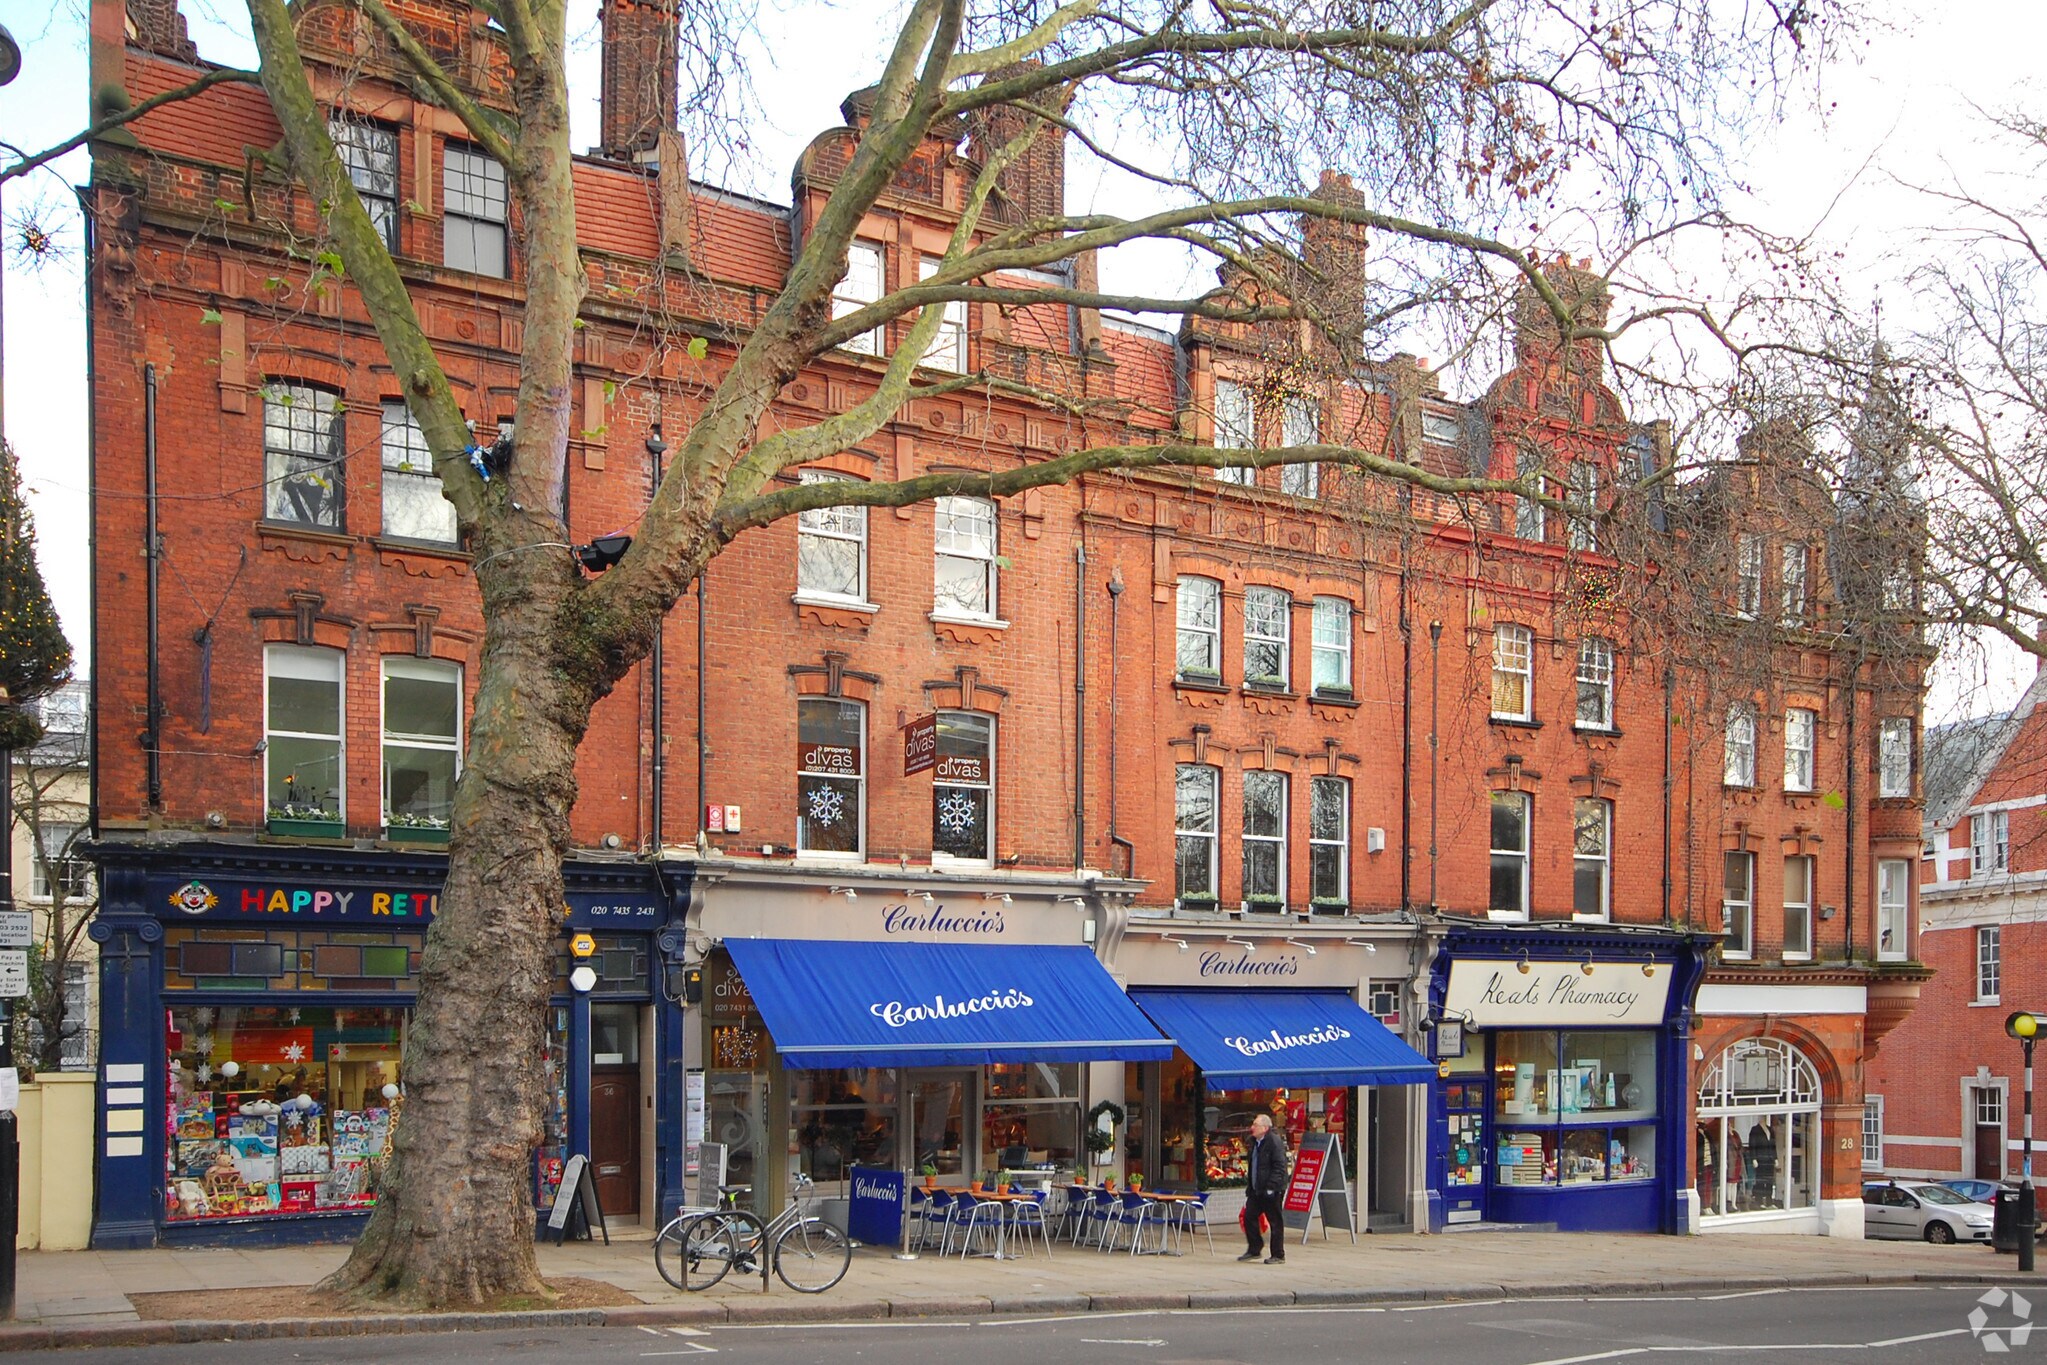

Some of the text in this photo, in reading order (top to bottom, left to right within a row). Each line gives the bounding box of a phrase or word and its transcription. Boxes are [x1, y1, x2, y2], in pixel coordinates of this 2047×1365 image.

[824, 746, 852, 755] property
[906, 734, 935, 757] divas
[805, 749, 853, 767] divas
[805, 765, 826, 773] (0)207
[937, 760, 981, 778] divas
[241, 889, 354, 914] HAPPY
[591, 906, 655, 916] 020 7435 2431
[882, 904, 1005, 933] Carluccio's
[1199, 951, 1298, 977] Carluccio's
[1480, 971, 1639, 1018] Keats Pharmacy
[715, 1004, 728, 1012] 020
[870, 988, 1034, 1027] Carluccio's
[1224, 1024, 1351, 1057] Carluccio's
[1841, 1138, 1853, 1150] 28
